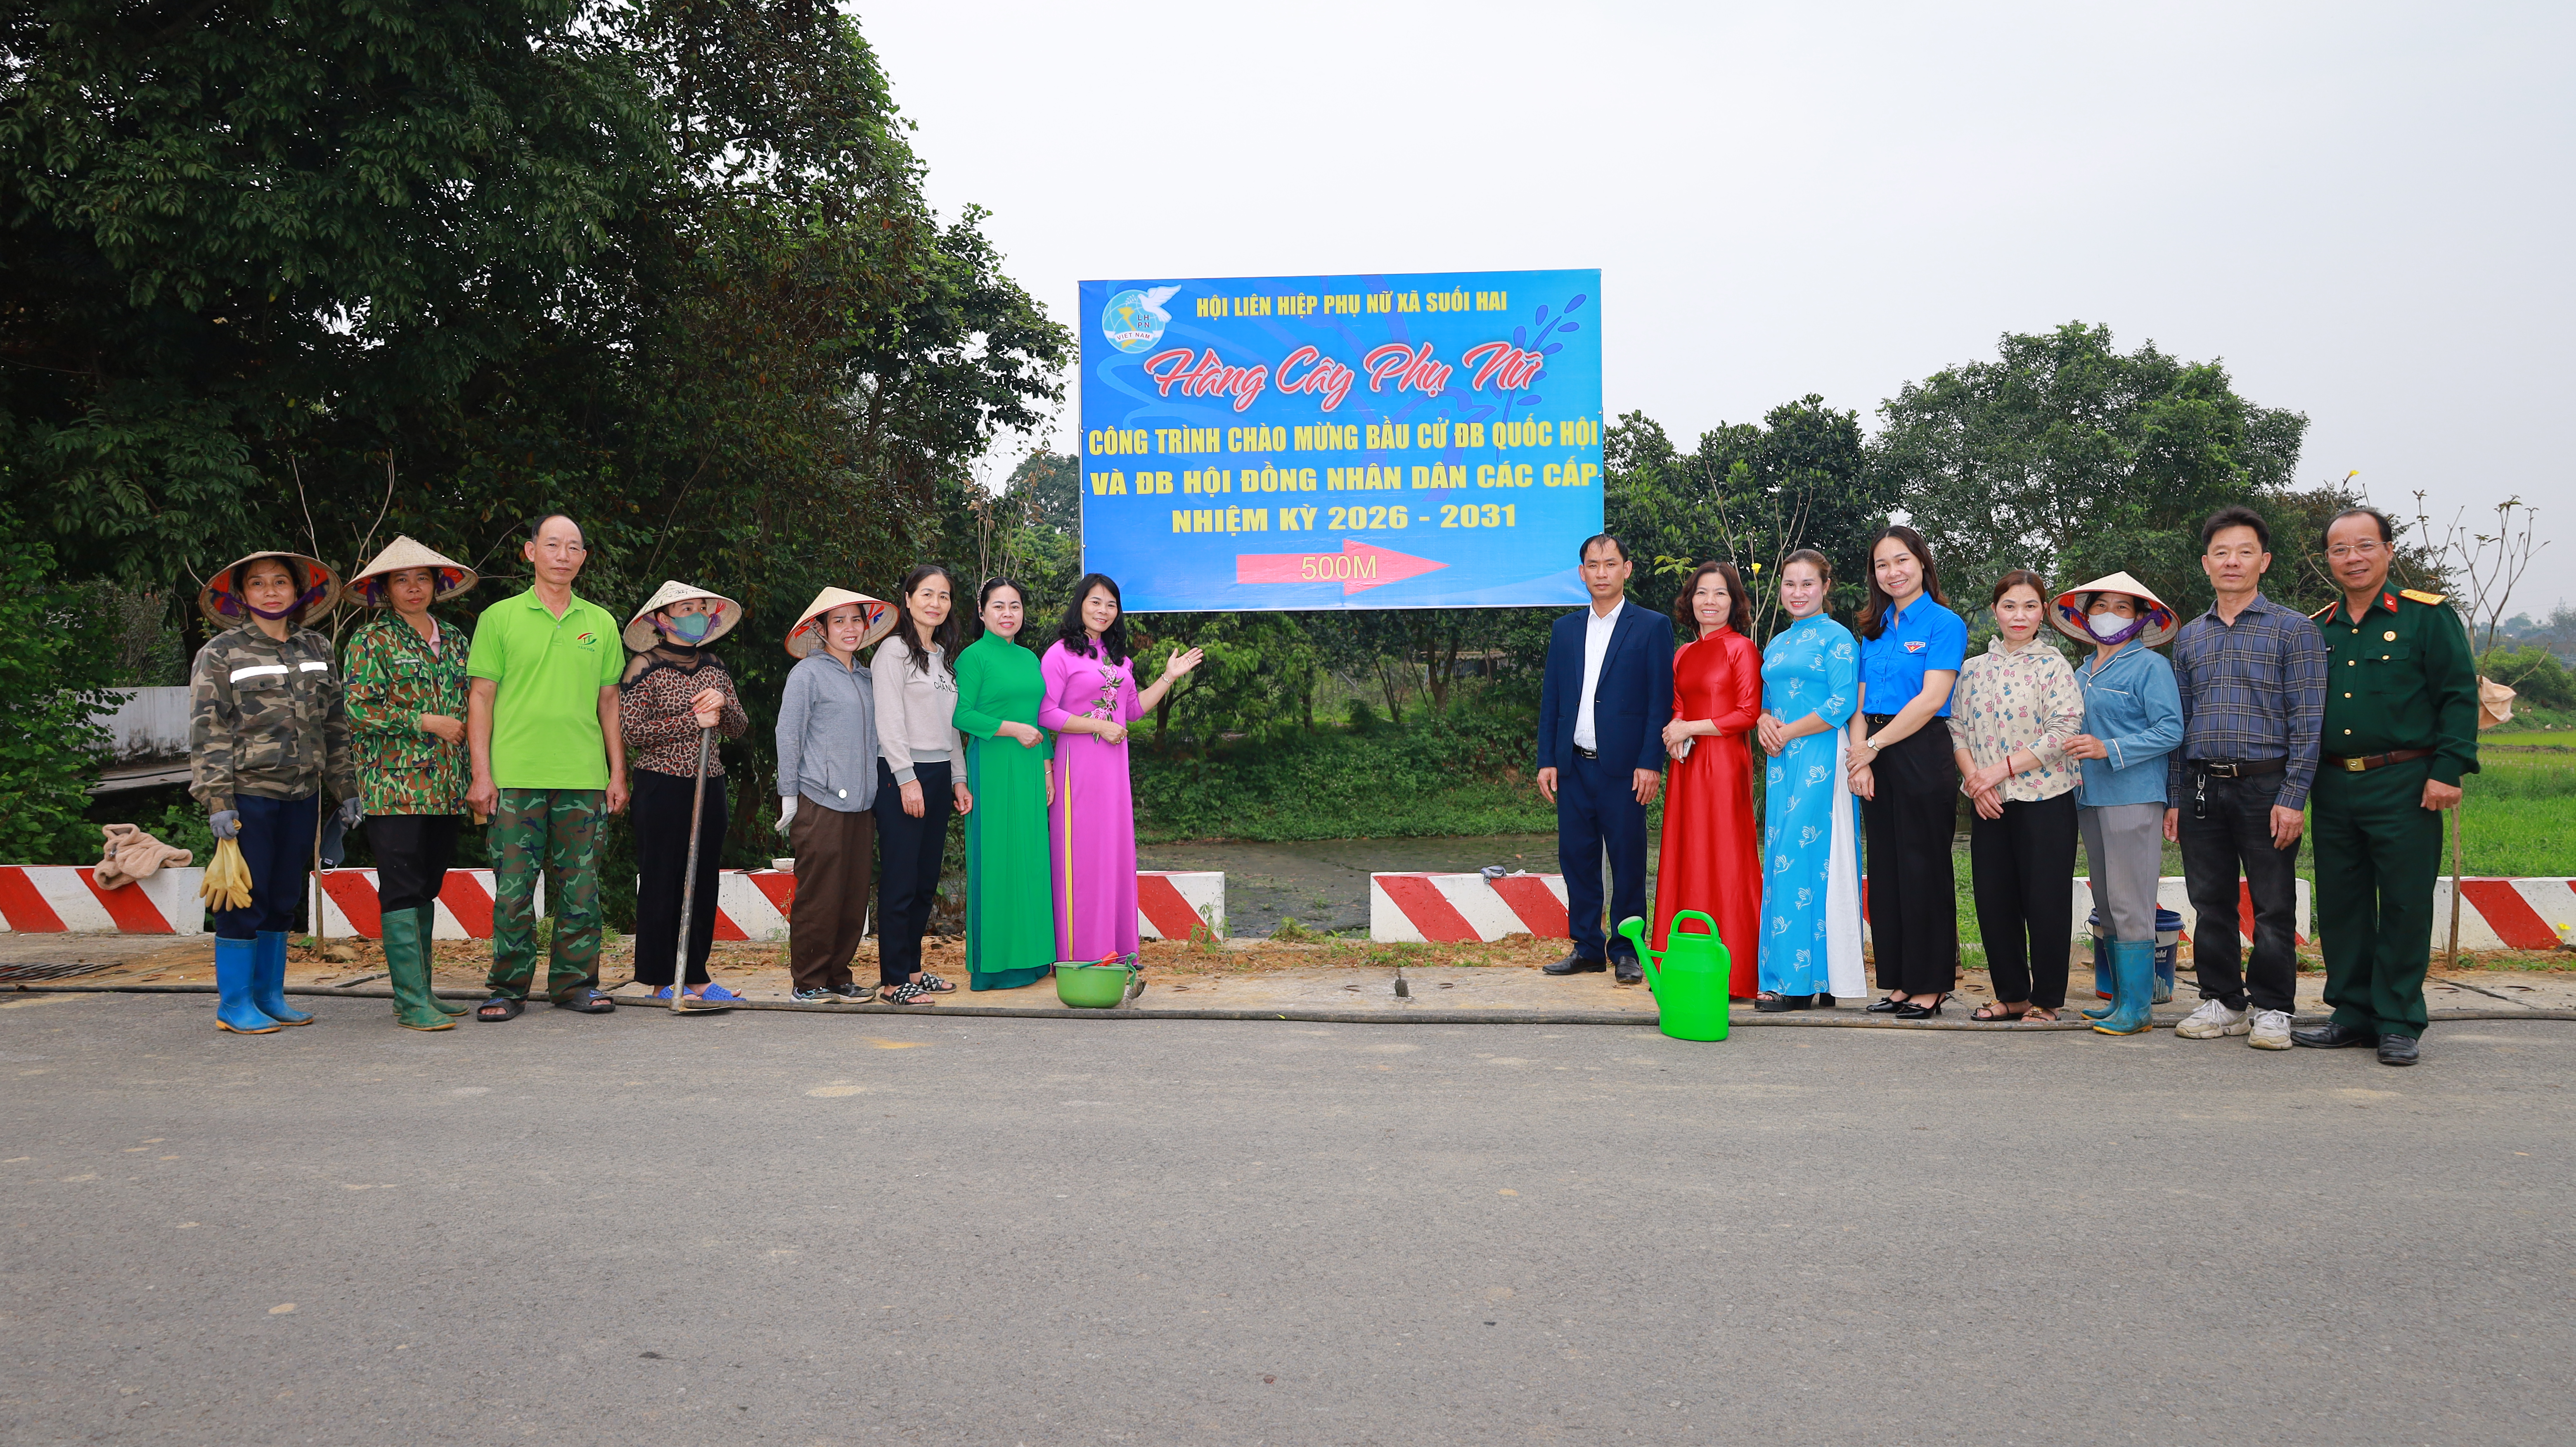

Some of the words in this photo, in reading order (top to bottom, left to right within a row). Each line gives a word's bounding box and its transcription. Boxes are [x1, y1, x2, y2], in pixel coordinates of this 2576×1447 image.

[1197, 294, 1228, 320] HỘI
[1234, 294, 1271, 316] LIÊN
[1278, 292, 1317, 318] HIỆP
[1324, 294, 1360, 317] PHỤ
[1367, 291, 1393, 313] NỮ
[1397, 290, 1421, 312] XÃ
[1426, 286, 1469, 312] SUỐI
[1476, 292, 1506, 311] HAI
[1144, 348, 1268, 412] Hàng
[1276, 345, 1355, 412] Cây
[1364, 342, 1453, 397] Phụ
[1462, 341, 1544, 391] Nữ
[1089, 425, 1148, 455] CÔNG
[1155, 425, 1220, 453] TRÌNH
[1228, 423, 1286, 453] CHÀO
[1294, 422, 1358, 451] MỪNG
[1366, 416, 1409, 449] BẦU
[1418, 417, 1449, 448] CỬ
[1454, 423, 1485, 448] ĐB
[1492, 413, 1552, 450] QUỐC
[1560, 416, 1598, 450] HỘI
[1090, 469, 1127, 495] VÀ
[1135, 471, 1173, 494] ĐB
[1184, 466, 1231, 497] HỘI
[1240, 461, 1316, 492] ĐỒNG
[1327, 463, 1401, 490] NHÂN
[1412, 462, 1466, 489] DÂN
[1477, 461, 1533, 488] CÁC
[1543, 456, 1597, 487] CẤP
[1172, 505, 1268, 536] NHIỆM
[1280, 504, 1318, 531] KỲ
[1328, 505, 1408, 530] 2026
[1440, 504, 1515, 528] 2031
[1301, 555, 1377, 580] 500M
